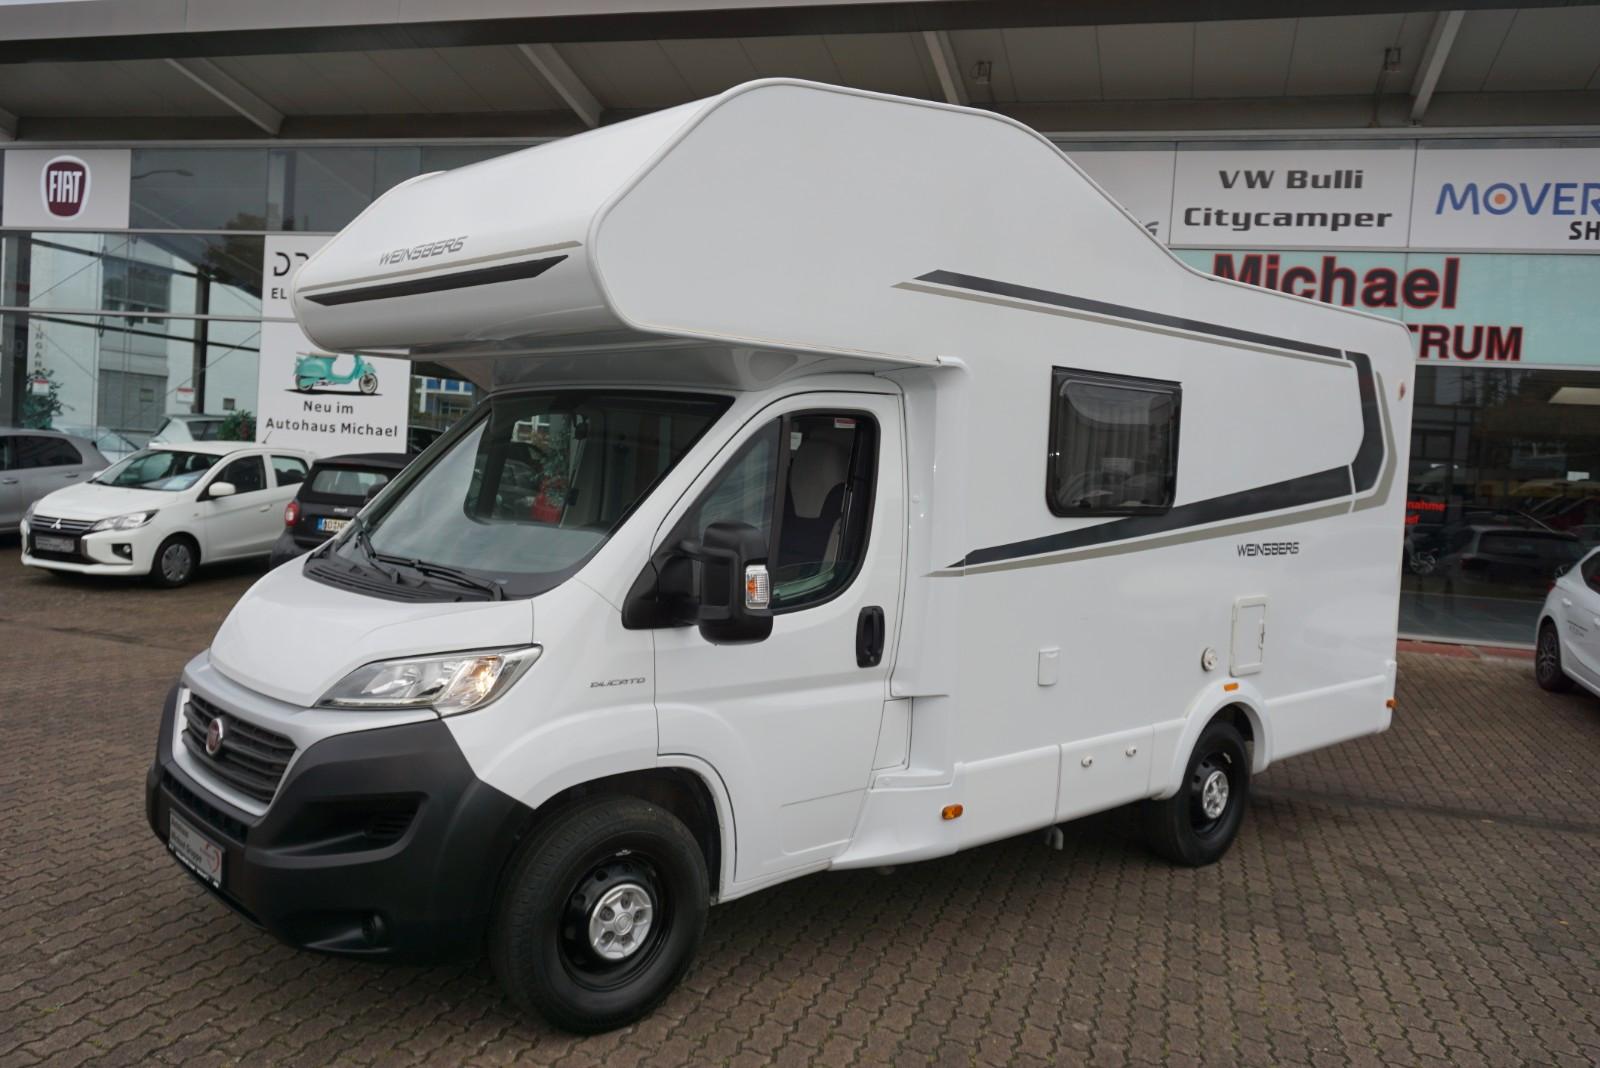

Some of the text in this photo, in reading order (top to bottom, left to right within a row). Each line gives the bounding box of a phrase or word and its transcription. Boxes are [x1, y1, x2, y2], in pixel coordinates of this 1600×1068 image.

[49, 170, 83, 203] FIAT
[1219, 170, 1364, 189] VW Bulli
[1184, 207, 1393, 231] Citycamper
[379, 235, 469, 266] WEINSBERG
[303, 400, 354, 414] Neu im
[265, 417, 399, 437] Autohaus Michael
[1237, 541, 1300, 557] WEINSBERG
